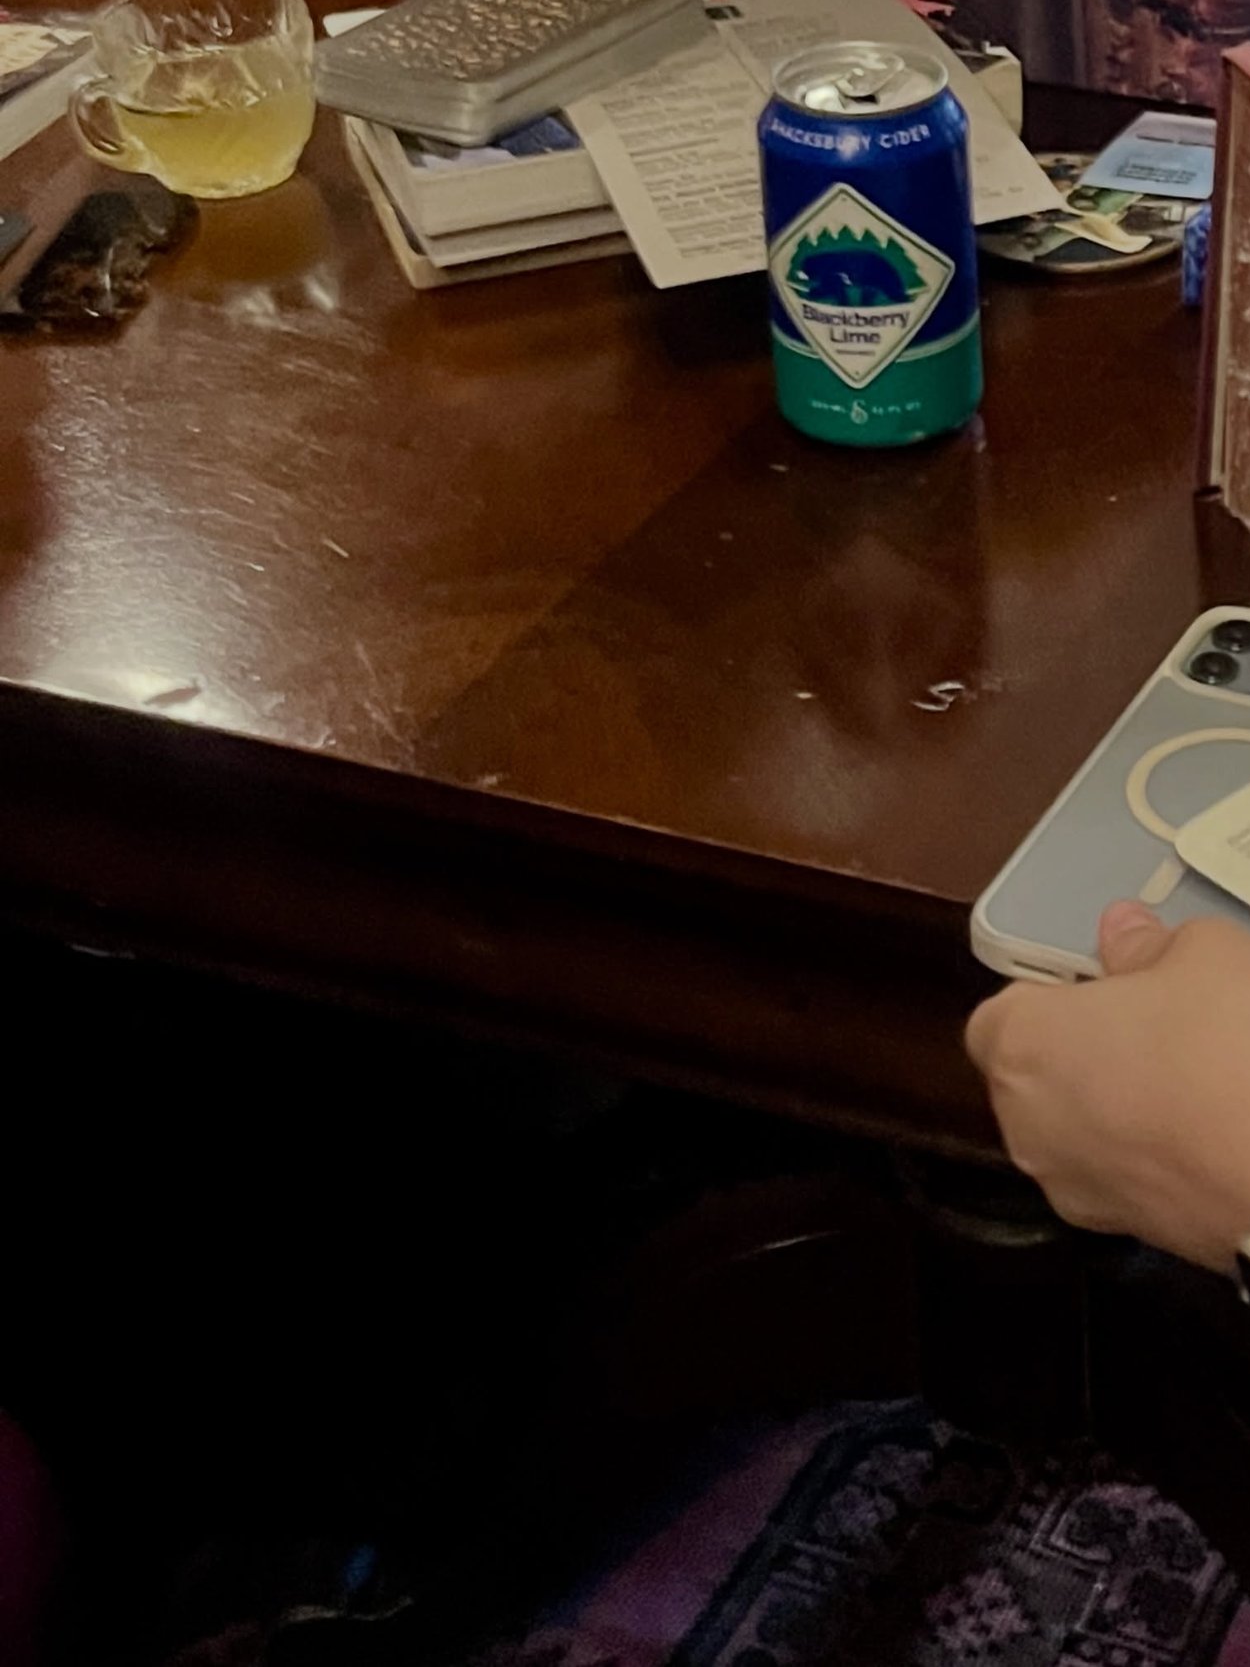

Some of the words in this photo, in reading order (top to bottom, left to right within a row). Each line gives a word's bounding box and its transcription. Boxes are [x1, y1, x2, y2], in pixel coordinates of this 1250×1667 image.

[879, 124, 931, 149] CIDER
[802, 303, 910, 329] Blackberry
[830, 328, 881, 344] Lime
